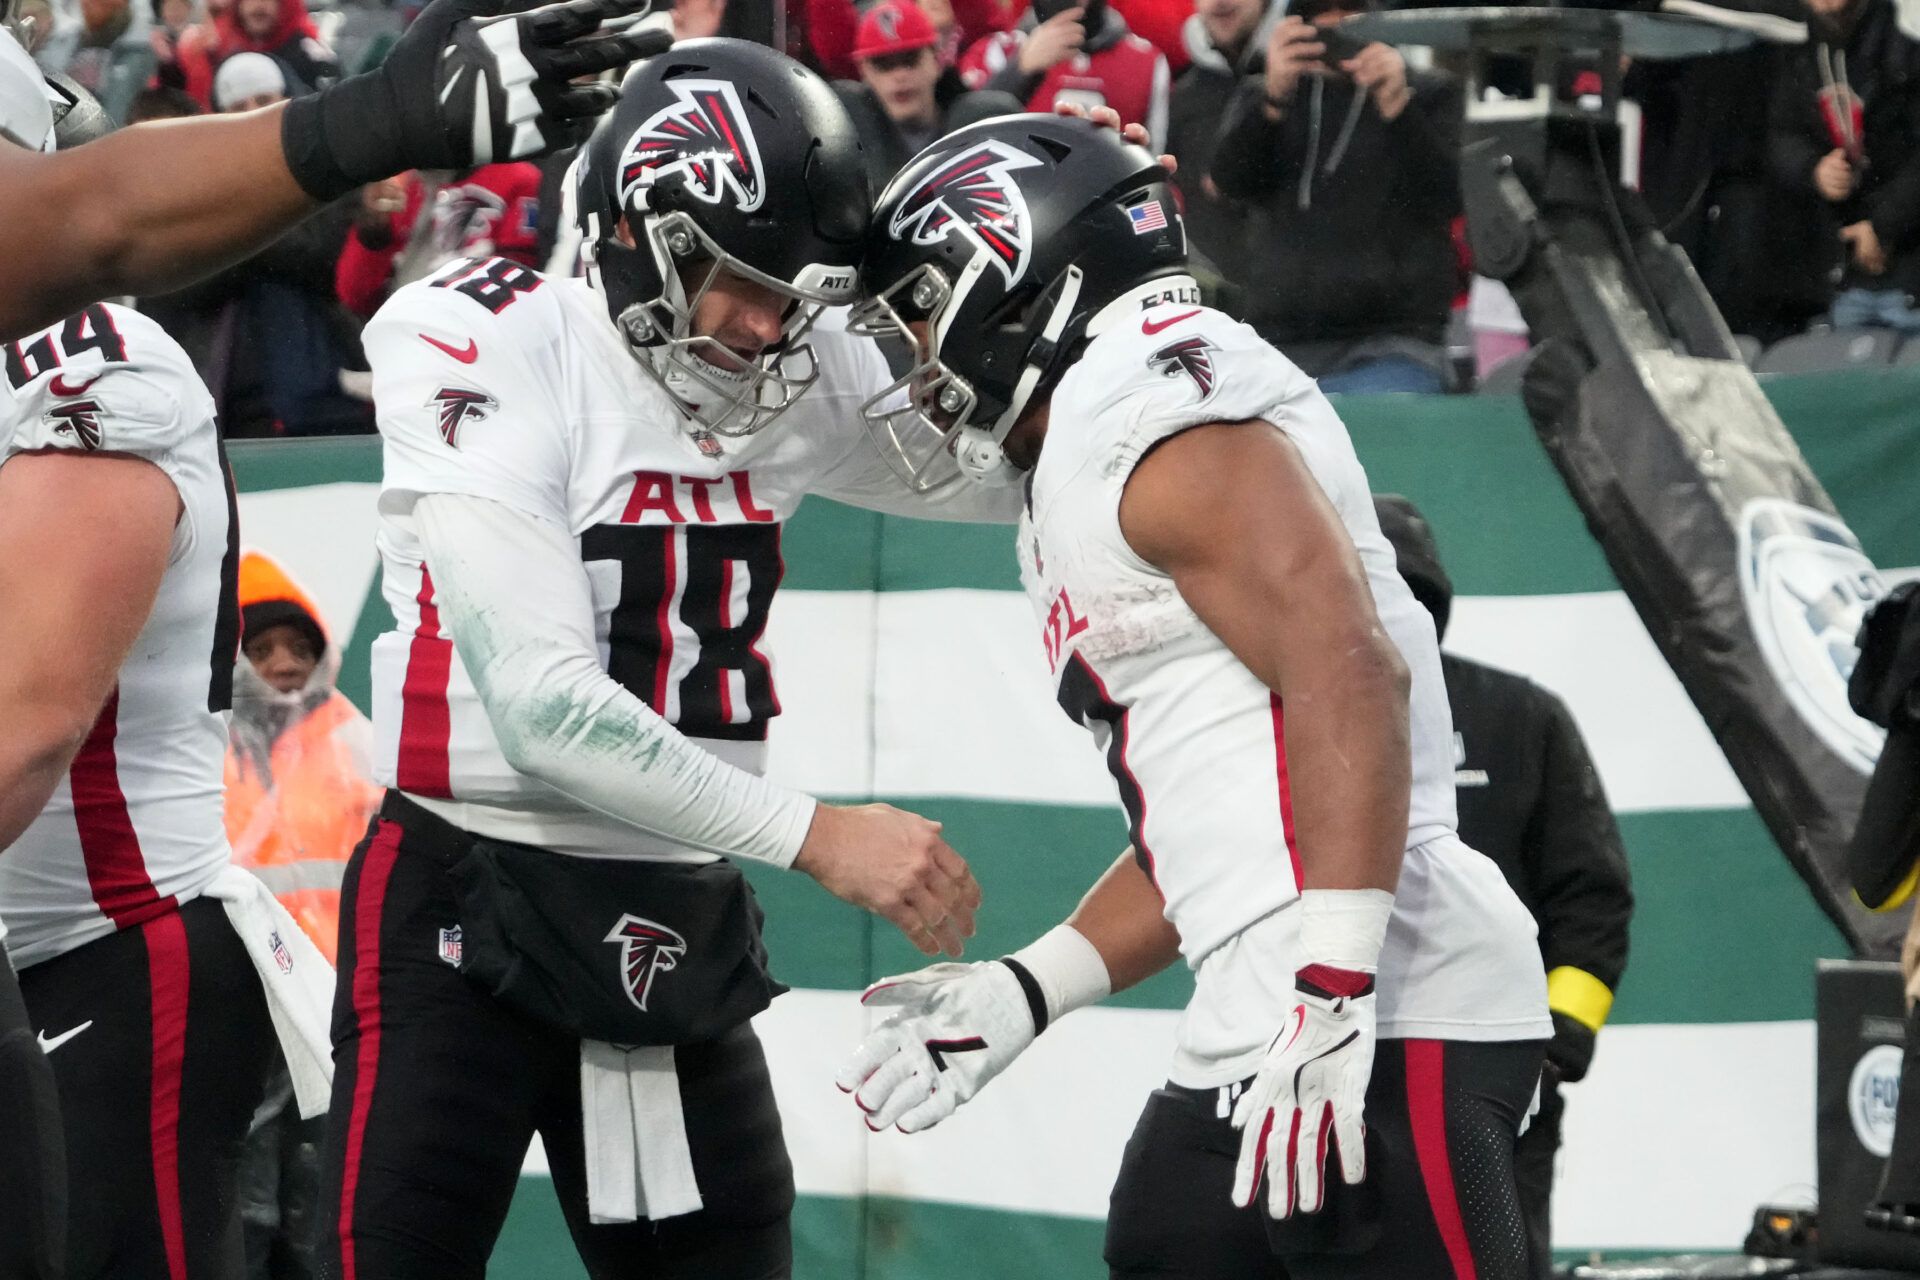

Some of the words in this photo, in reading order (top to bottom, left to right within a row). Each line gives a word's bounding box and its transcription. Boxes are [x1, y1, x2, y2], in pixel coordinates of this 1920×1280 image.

[820, 276, 850, 289] ATL
[620, 470, 774, 524] ATL
[581, 522, 784, 741] 18
[1873, 1075, 1900, 1108] FO
